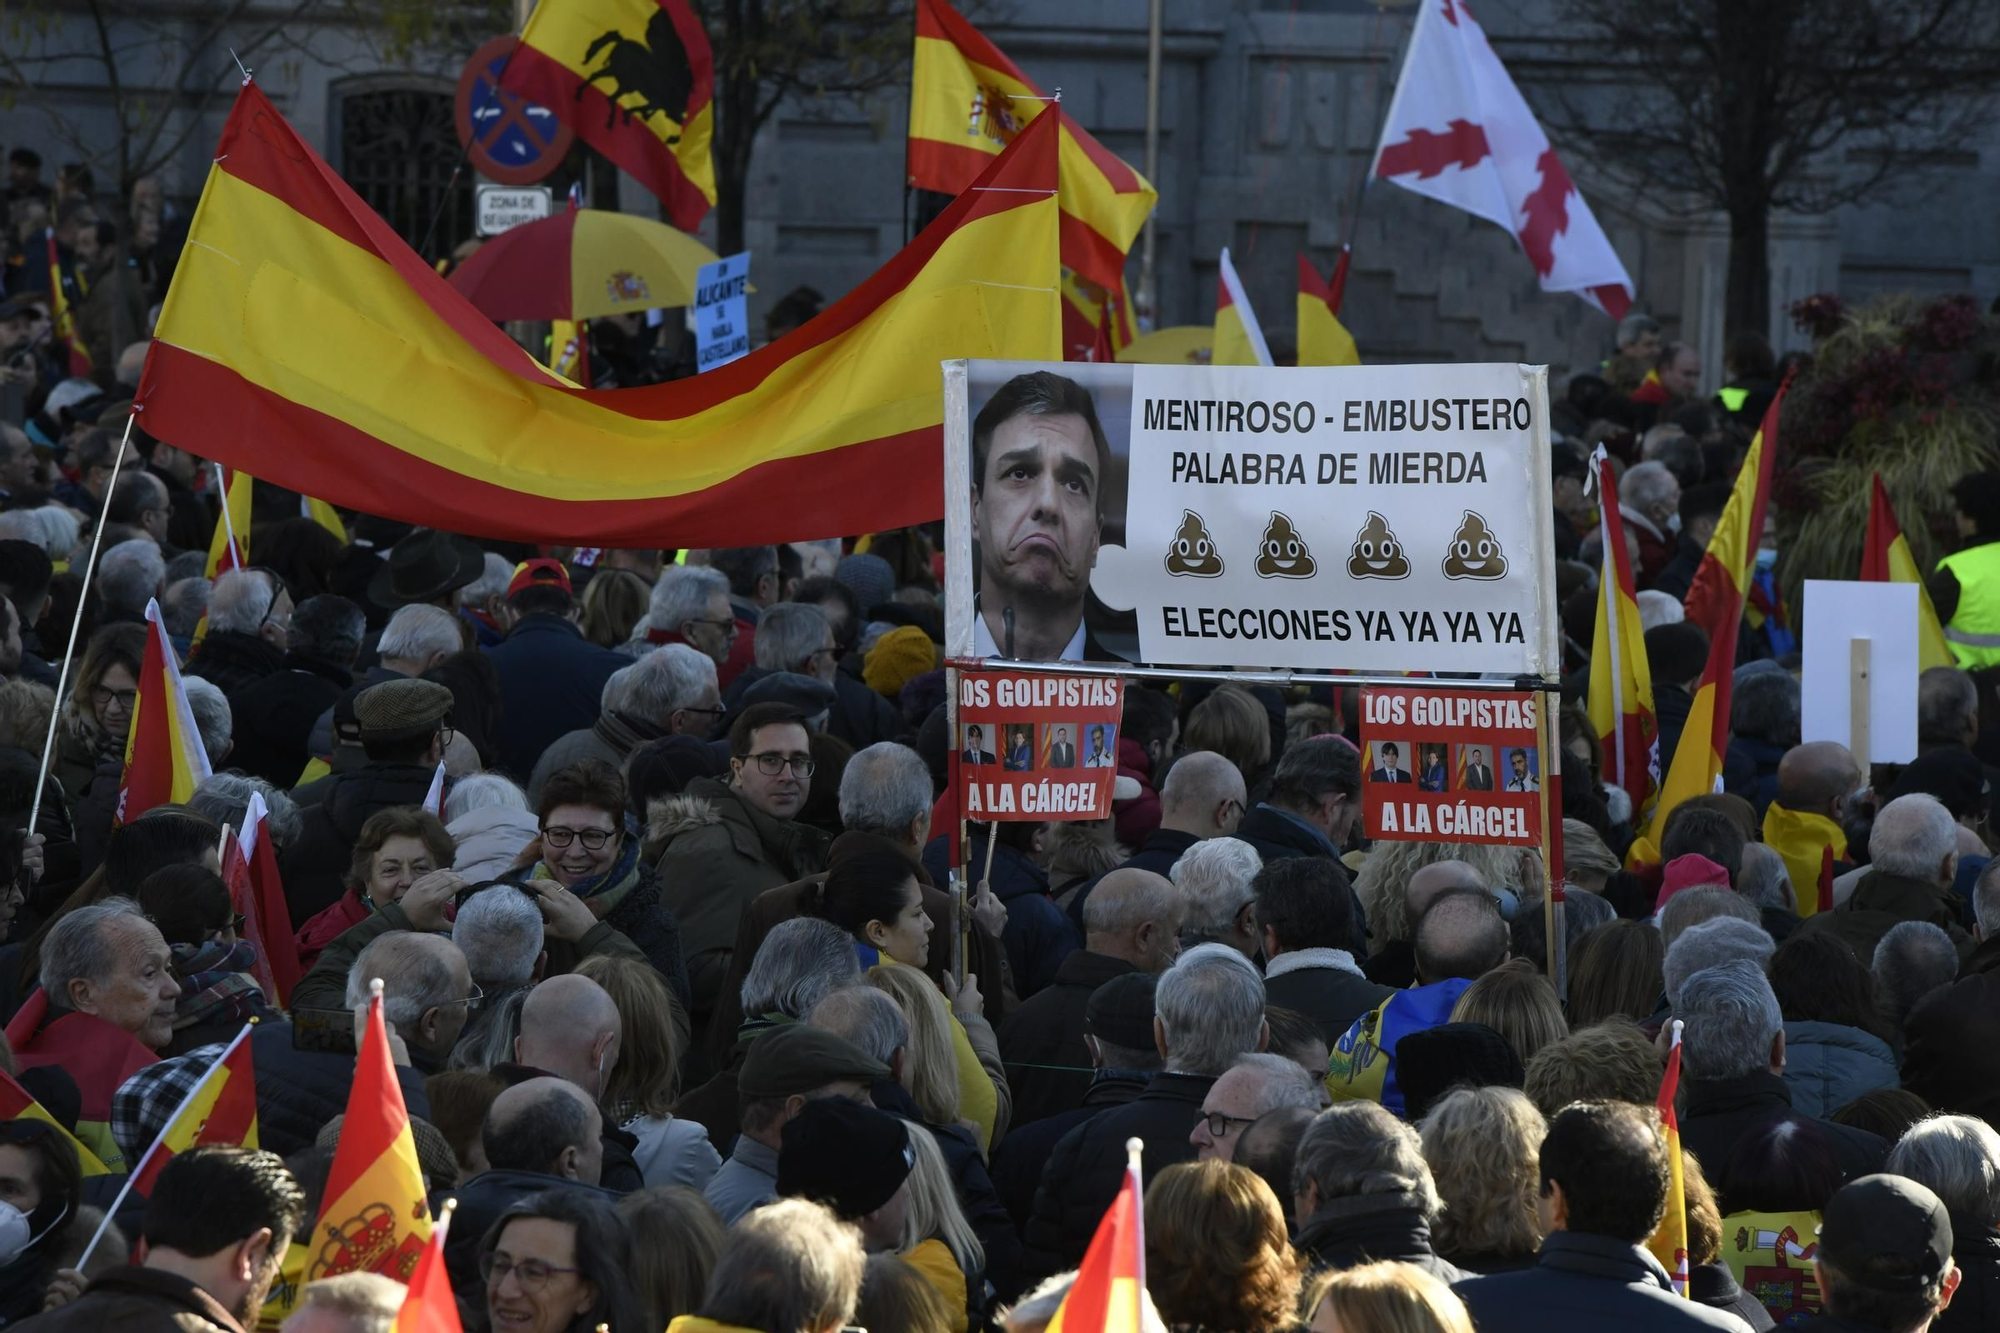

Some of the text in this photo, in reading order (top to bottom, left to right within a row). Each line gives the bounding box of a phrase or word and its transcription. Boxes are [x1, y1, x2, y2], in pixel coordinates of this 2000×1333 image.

[489, 195, 518, 209] ZONA
[696, 275, 747, 309] ALICANTE
[700, 335, 747, 365] CASTELLANO
[1143, 398, 1316, 433] MENTIROSO
[1343, 397, 1532, 432] EMBUSTERO
[1171, 451, 1487, 485] PALABRA DE MIERDA
[1162, 607, 1525, 643] ELECCIONES YA YA YA YA
[996, 678, 1117, 707] GOLPISTAS
[1365, 694, 1537, 729] LOS GOLPISTAS
[968, 778, 1096, 813] A LA CÁRCEL
[1381, 799, 1529, 838] A LA CÁRCEL
